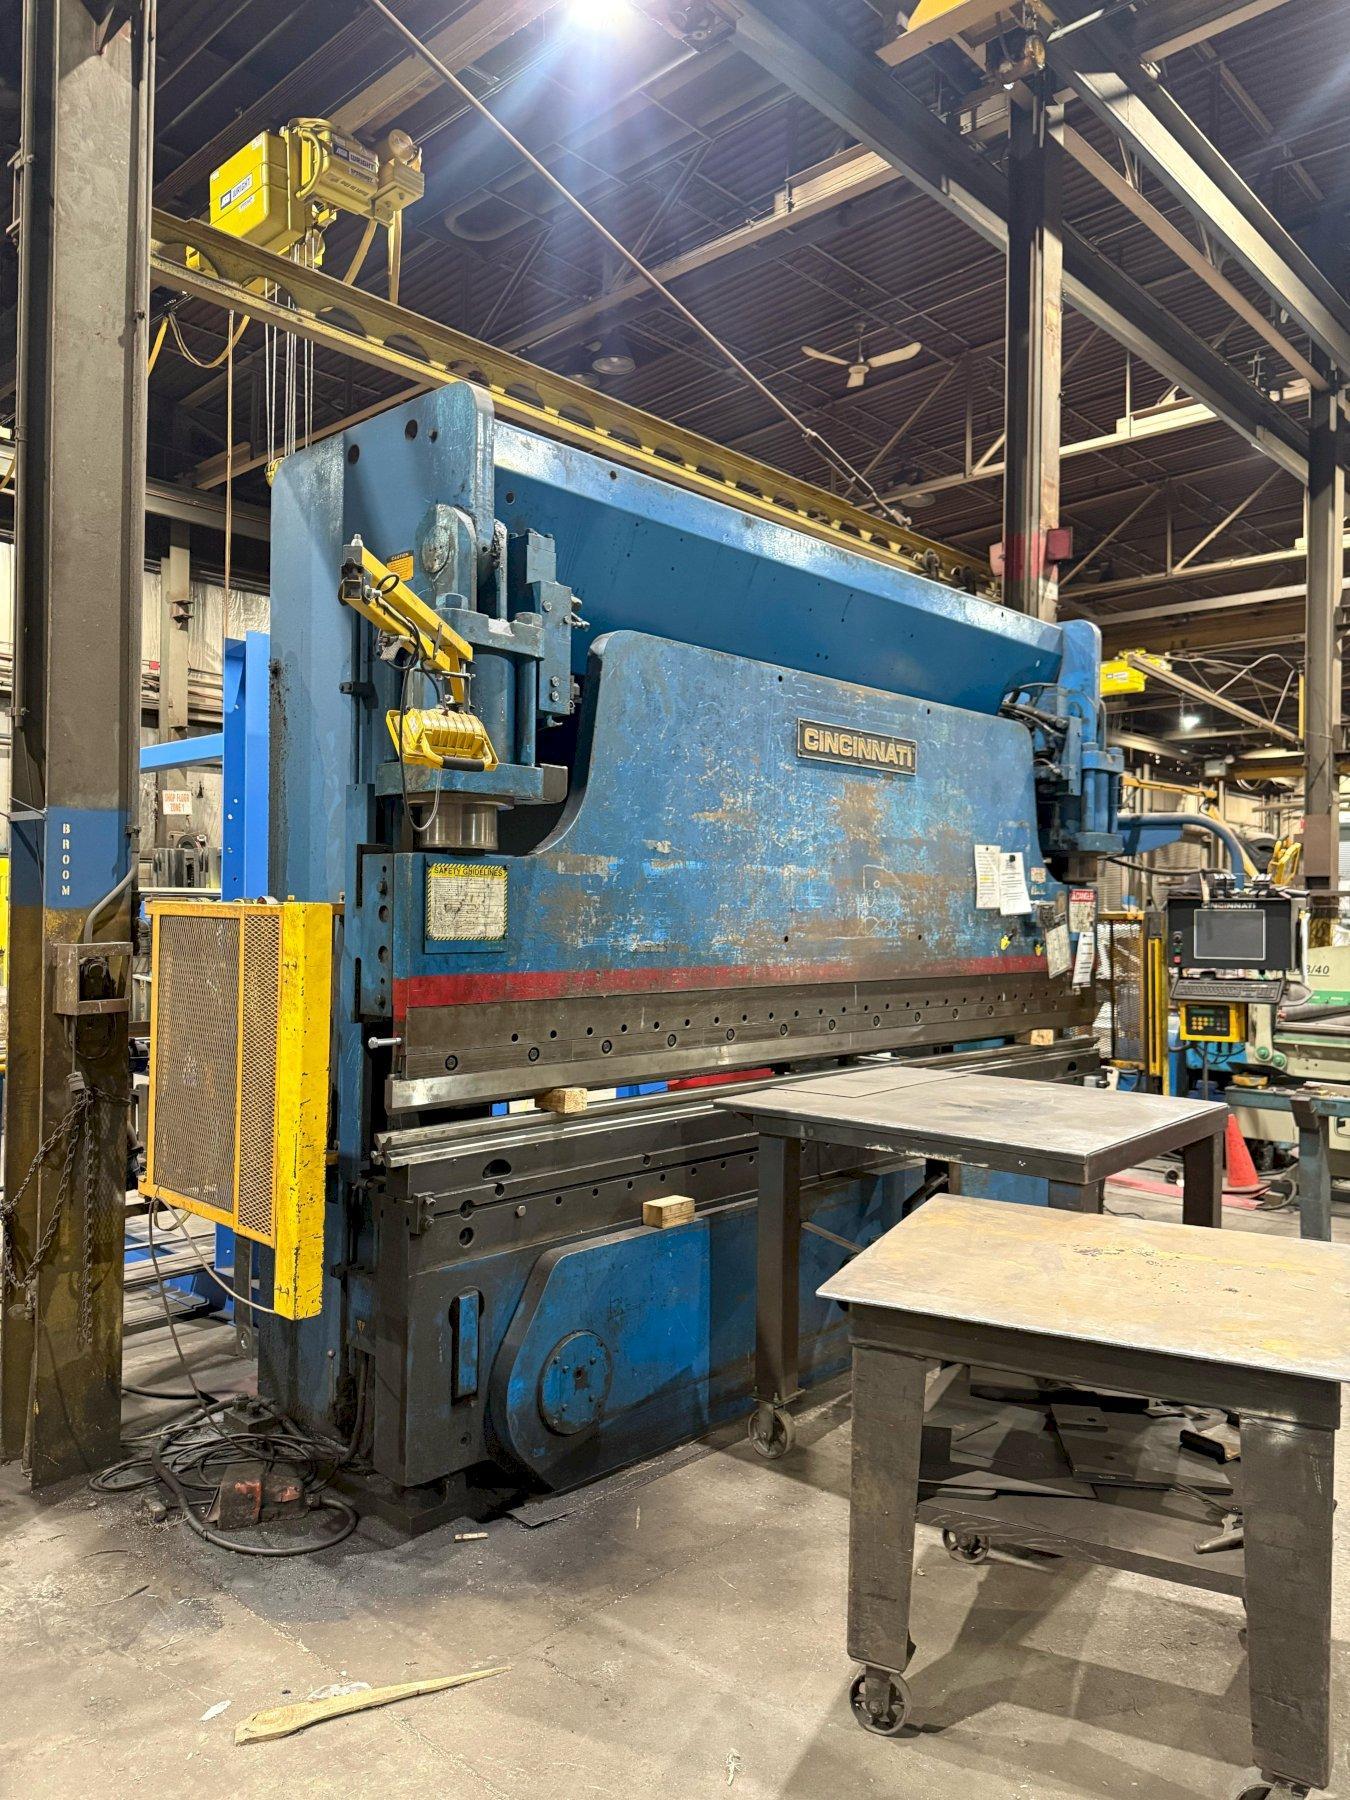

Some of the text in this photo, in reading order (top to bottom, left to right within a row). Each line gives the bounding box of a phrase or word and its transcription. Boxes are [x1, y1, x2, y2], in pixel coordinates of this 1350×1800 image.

[350, 154, 375, 171] WRIGHT
[391, 553, 409, 561] CAUTION
[804, 727, 913, 767] CINCINNATI
[61, 823, 72, 896] BROOM
[434, 867, 503, 877] SAFETY GUIDELINES
